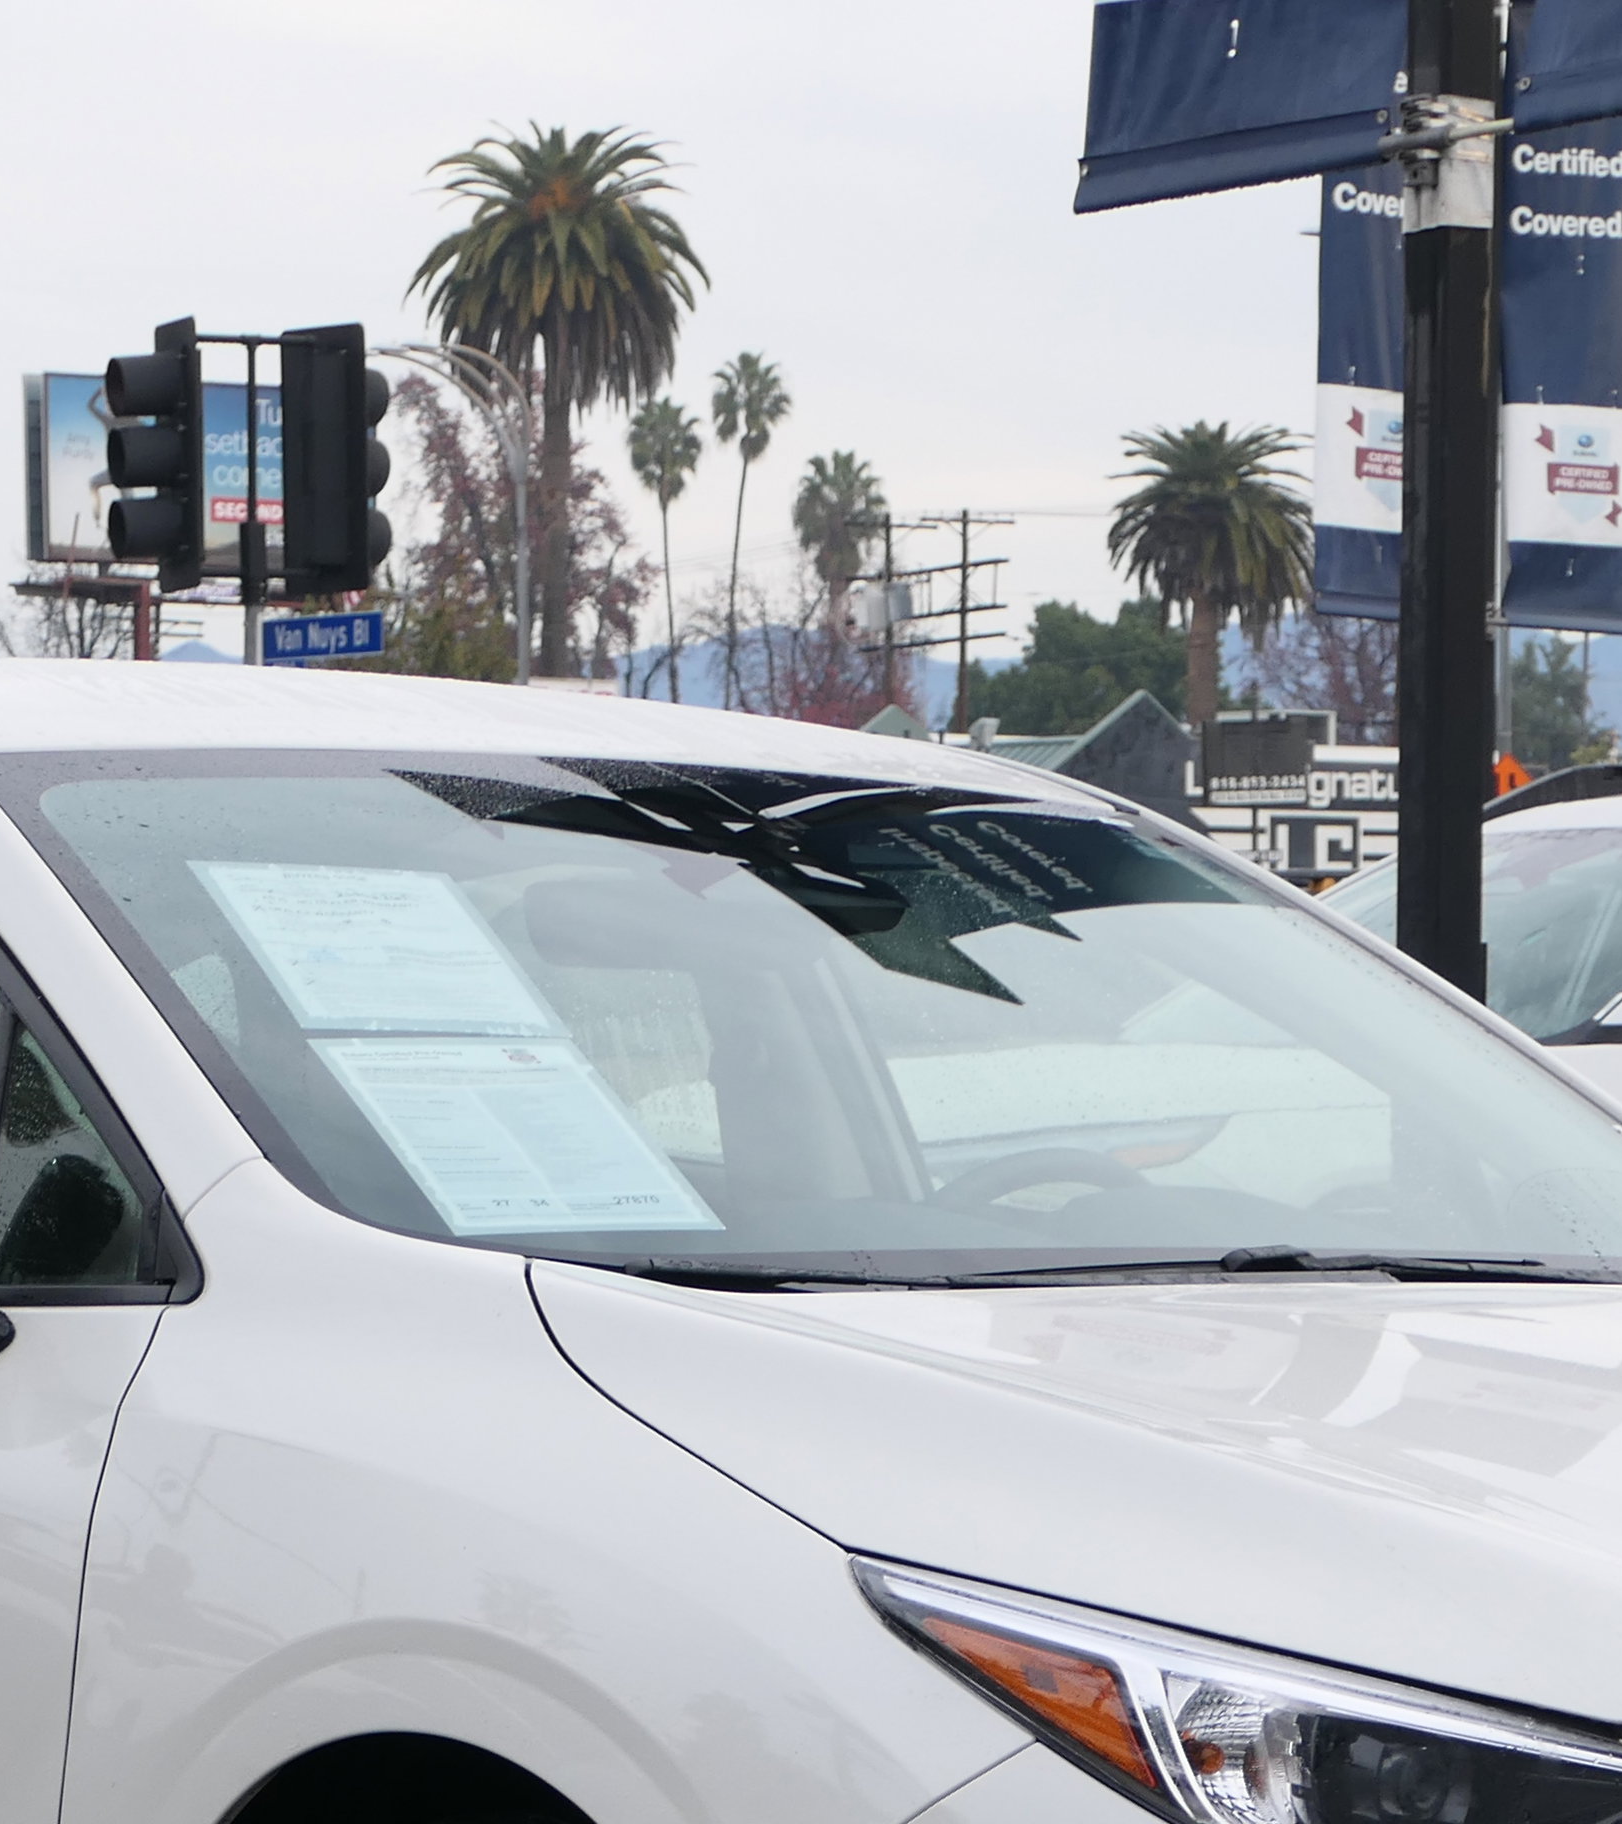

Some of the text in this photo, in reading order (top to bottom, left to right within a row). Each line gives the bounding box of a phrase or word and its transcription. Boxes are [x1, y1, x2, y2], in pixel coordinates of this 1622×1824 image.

[275, 618, 370, 654] Van Nuys Bl
